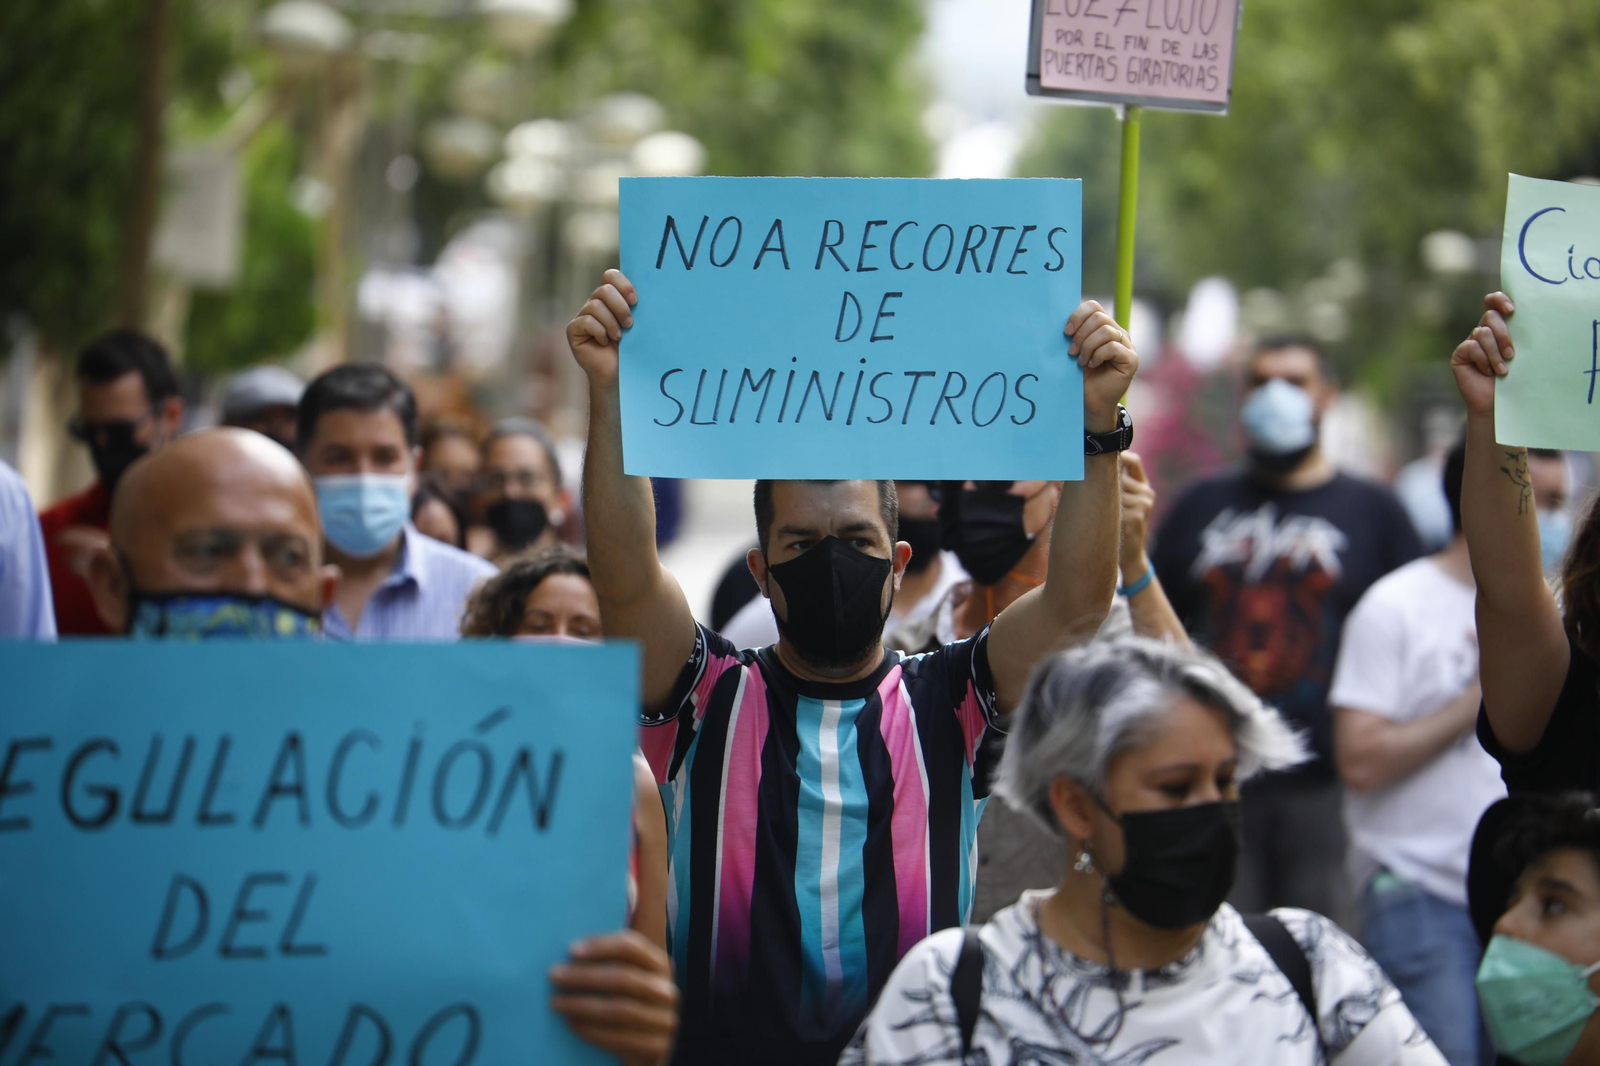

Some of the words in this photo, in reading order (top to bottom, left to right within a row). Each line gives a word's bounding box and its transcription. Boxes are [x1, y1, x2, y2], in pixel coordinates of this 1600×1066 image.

[1044, 48, 1118, 82] PUERTAS
[1127, 56, 1219, 92] GIRATORIAS
[1055, 28, 1084, 46] POR
[1094, 32, 1115, 50] EL
[1124, 35, 1149, 51] FIN
[1161, 38, 1181, 56] DE
[1192, 42, 1218, 60] LAS
[655, 215, 742, 271] NO
[753, 218, 790, 270] A
[814, 219, 1068, 275] RECORTES
[834, 291, 903, 343] DE
[150, 873, 329, 960] DEL
[0, 1002, 483, 1066] ERCADO
